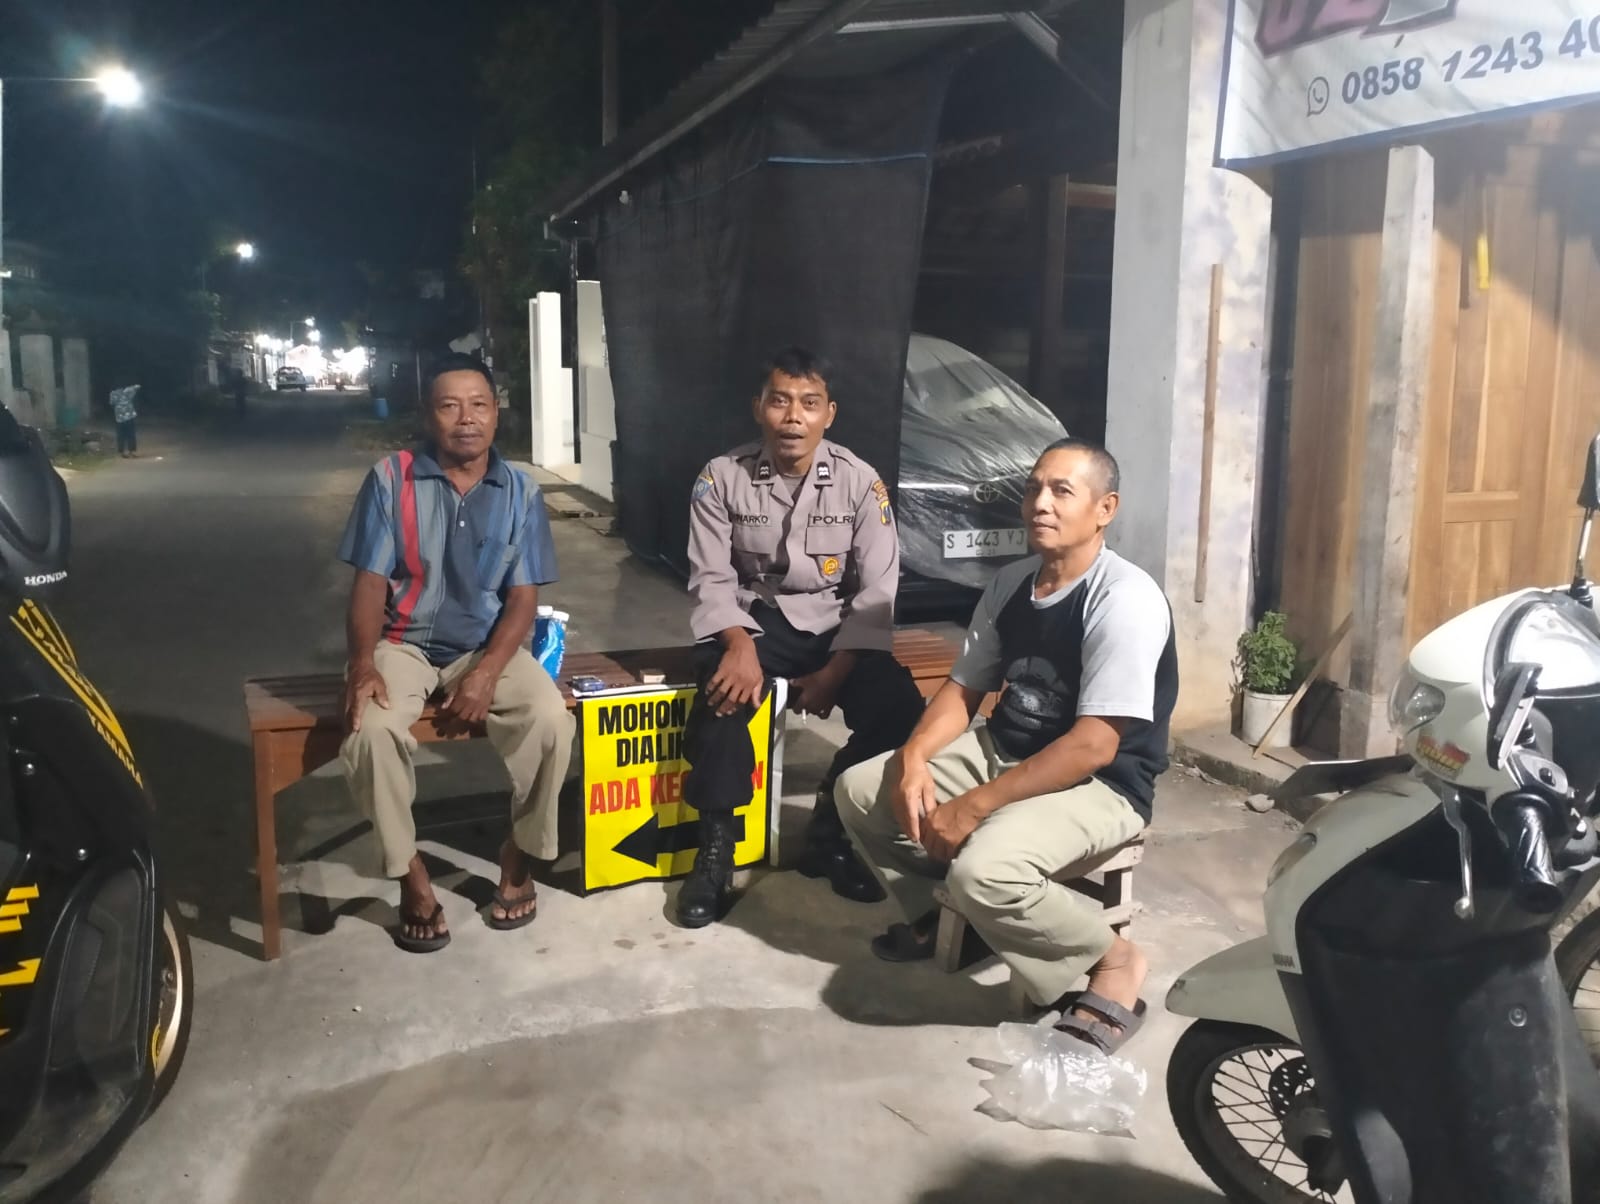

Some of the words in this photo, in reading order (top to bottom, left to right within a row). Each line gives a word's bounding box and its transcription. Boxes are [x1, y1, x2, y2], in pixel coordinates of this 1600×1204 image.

[1342, 57, 1425, 105] 0858
[1442, 30, 1544, 82] 1243
[946, 533, 955, 550] S
[965, 531, 1000, 549] 1443
[23, 570, 68, 586] HONDA
[598, 697, 687, 736] MOHON
[589, 777, 642, 816] ADA
